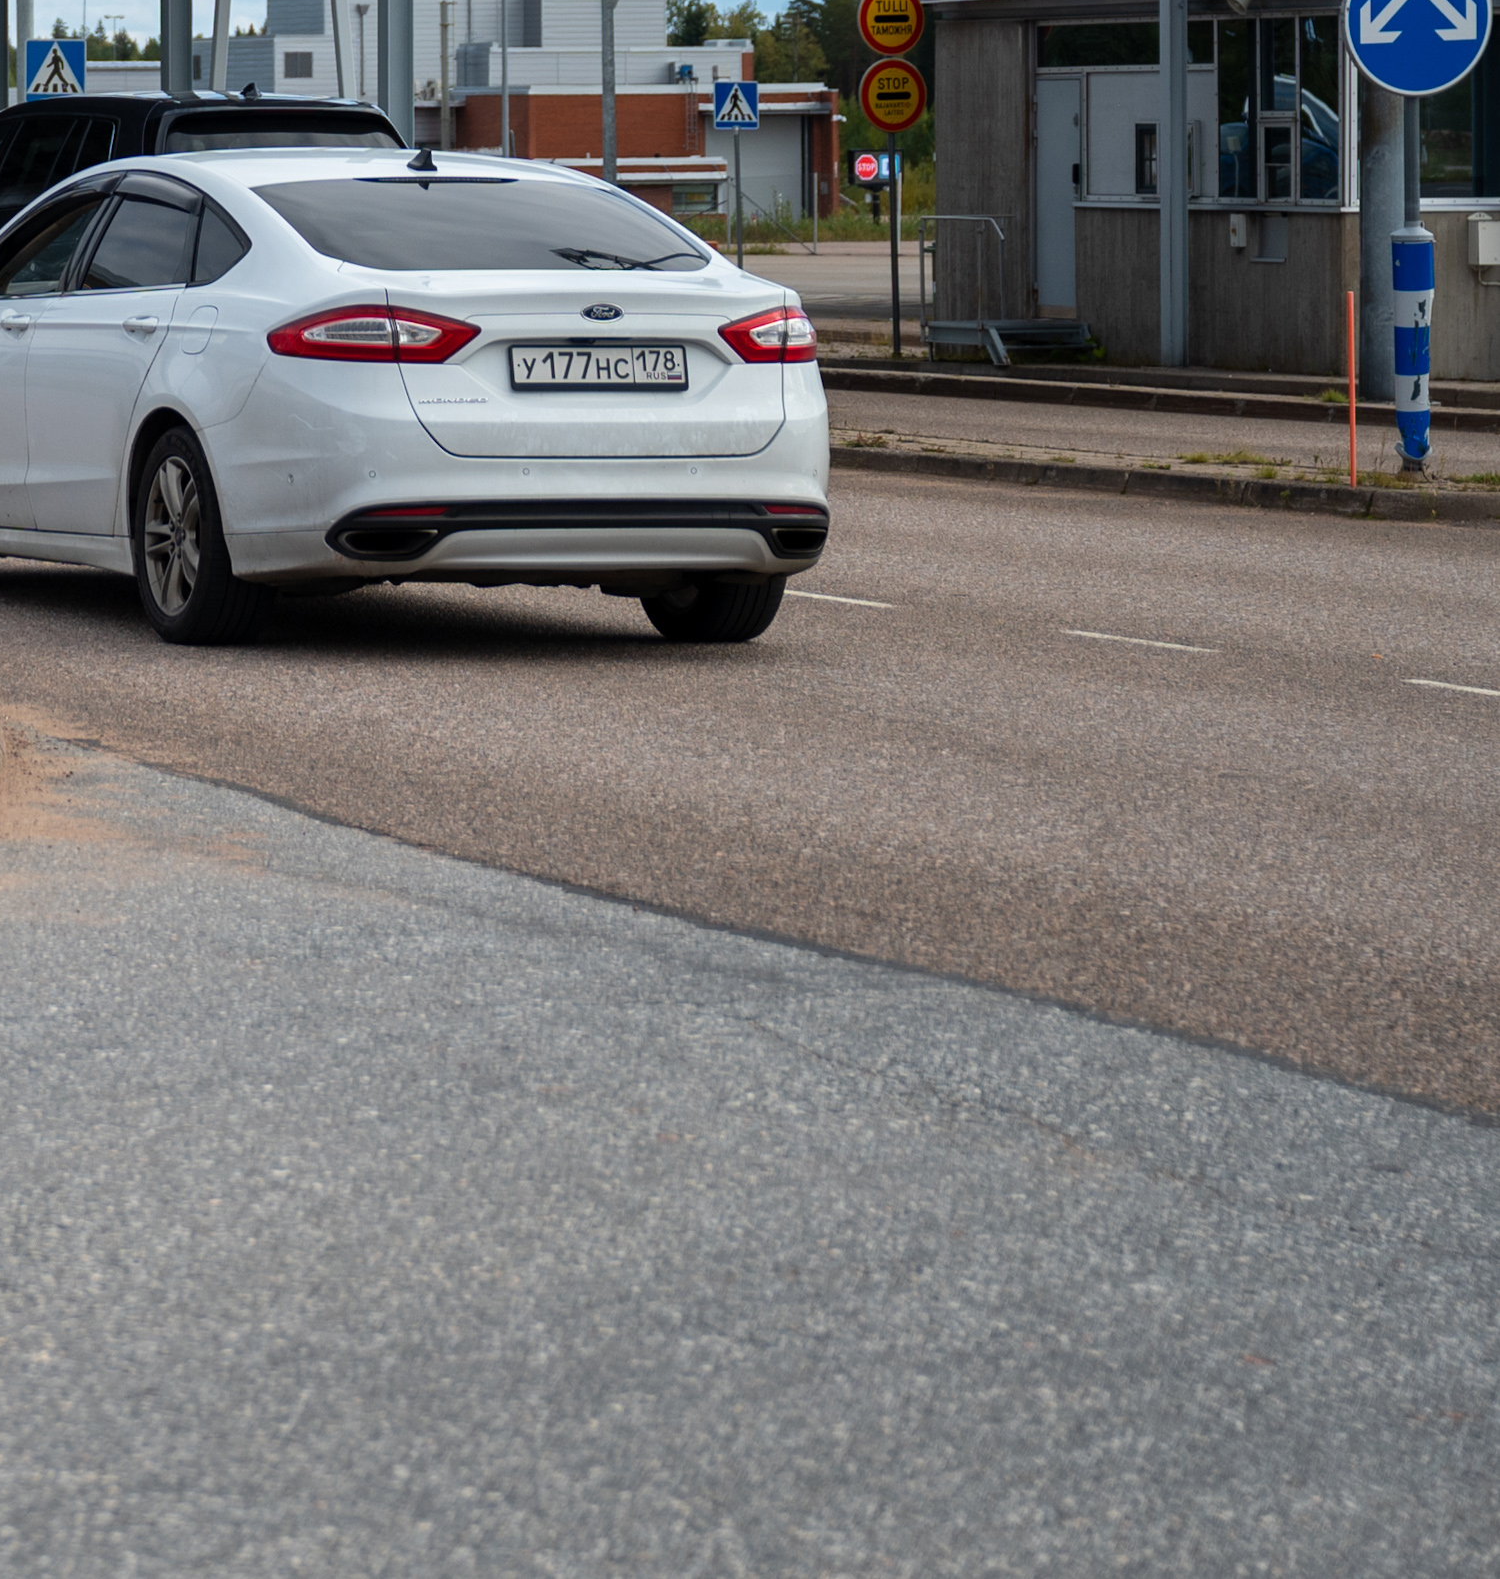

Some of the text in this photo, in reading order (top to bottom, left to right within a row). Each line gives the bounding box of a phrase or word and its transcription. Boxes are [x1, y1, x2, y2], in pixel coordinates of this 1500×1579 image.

[875, 0, 908, 12] TULLI
[871, 24, 913, 36] ТАМОЖНЯ
[878, 77, 910, 90] STOP
[858, 163, 876, 172] STOP
[635, 350, 676, 372] 178
[646, 372, 667, 380] RUS
[418, 397, 489, 405] MONDEO
